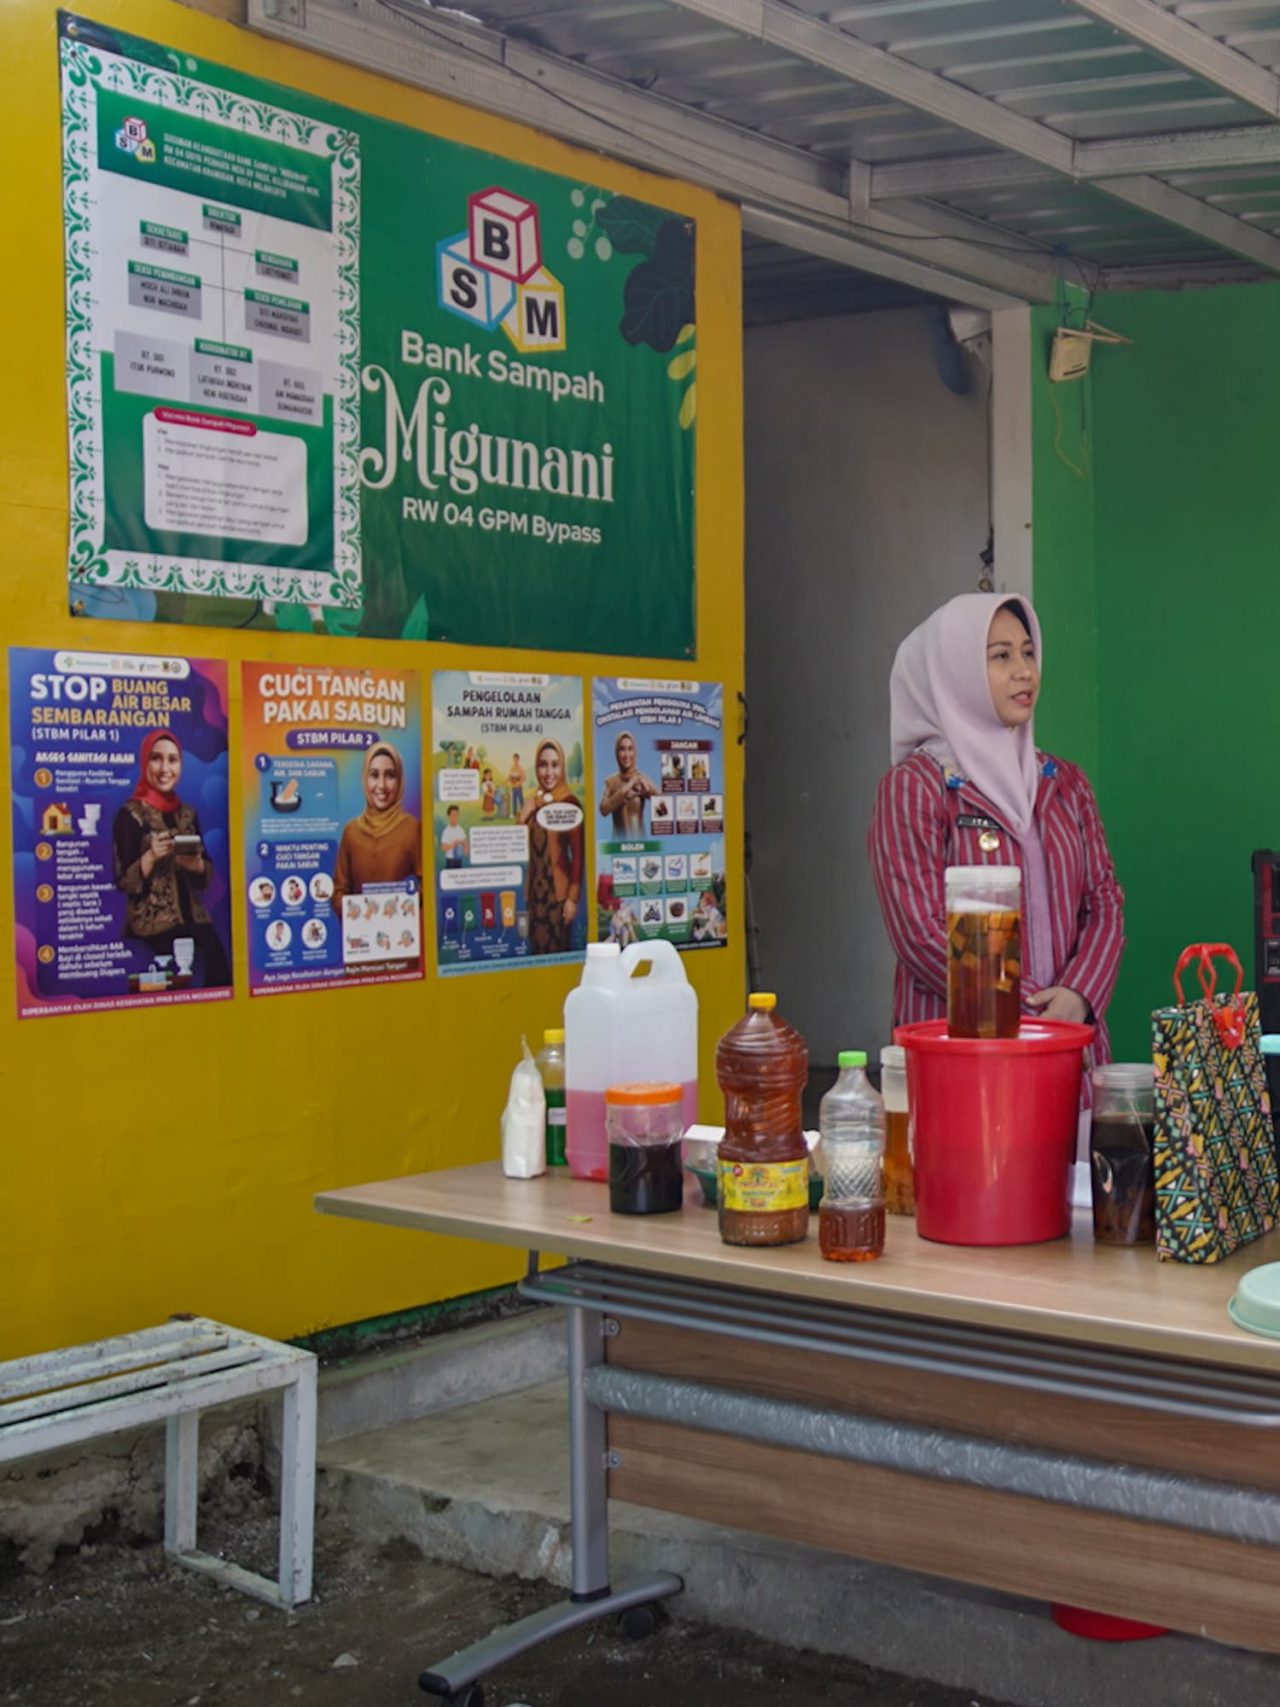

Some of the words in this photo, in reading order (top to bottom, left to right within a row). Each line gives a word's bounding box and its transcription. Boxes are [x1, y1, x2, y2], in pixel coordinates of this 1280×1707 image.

[483, 219, 511, 260] B
[450, 268, 478, 308] S
[525, 297, 558, 338] M
[401, 330, 481, 376] Bank
[488, 350, 605, 402] Sampah
[360, 364, 615, 502] Migunani
[403, 497, 439, 523] RW
[443, 505, 474, 528] 04
[479, 508, 528, 534] GPM
[532, 516, 602, 545] Bypass
[30, 674, 107, 701] STOP
[112, 678, 168, 695] BUANG
[259, 674, 313, 697] CUCI
[318, 675, 405, 702] TANGAN
[463, 690, 541, 704] PENGELOLAAN
[31, 706, 170, 728] SEMBARANGAN
[112, 695, 139, 709] AIR
[142, 696, 191, 712] BESAR
[264, 700, 330, 724] PAKAI
[334, 702, 406, 728] SABUN
[447, 706, 493, 717] SAMPAH
[496, 708, 532, 719] RUMAH
[535, 708, 572, 720] TANGGA
[32, 727, 70, 741] (STBM
[72, 728, 107, 741] PILAR
[297, 732, 329, 745] STBM
[330, 732, 364, 744] PILAR
